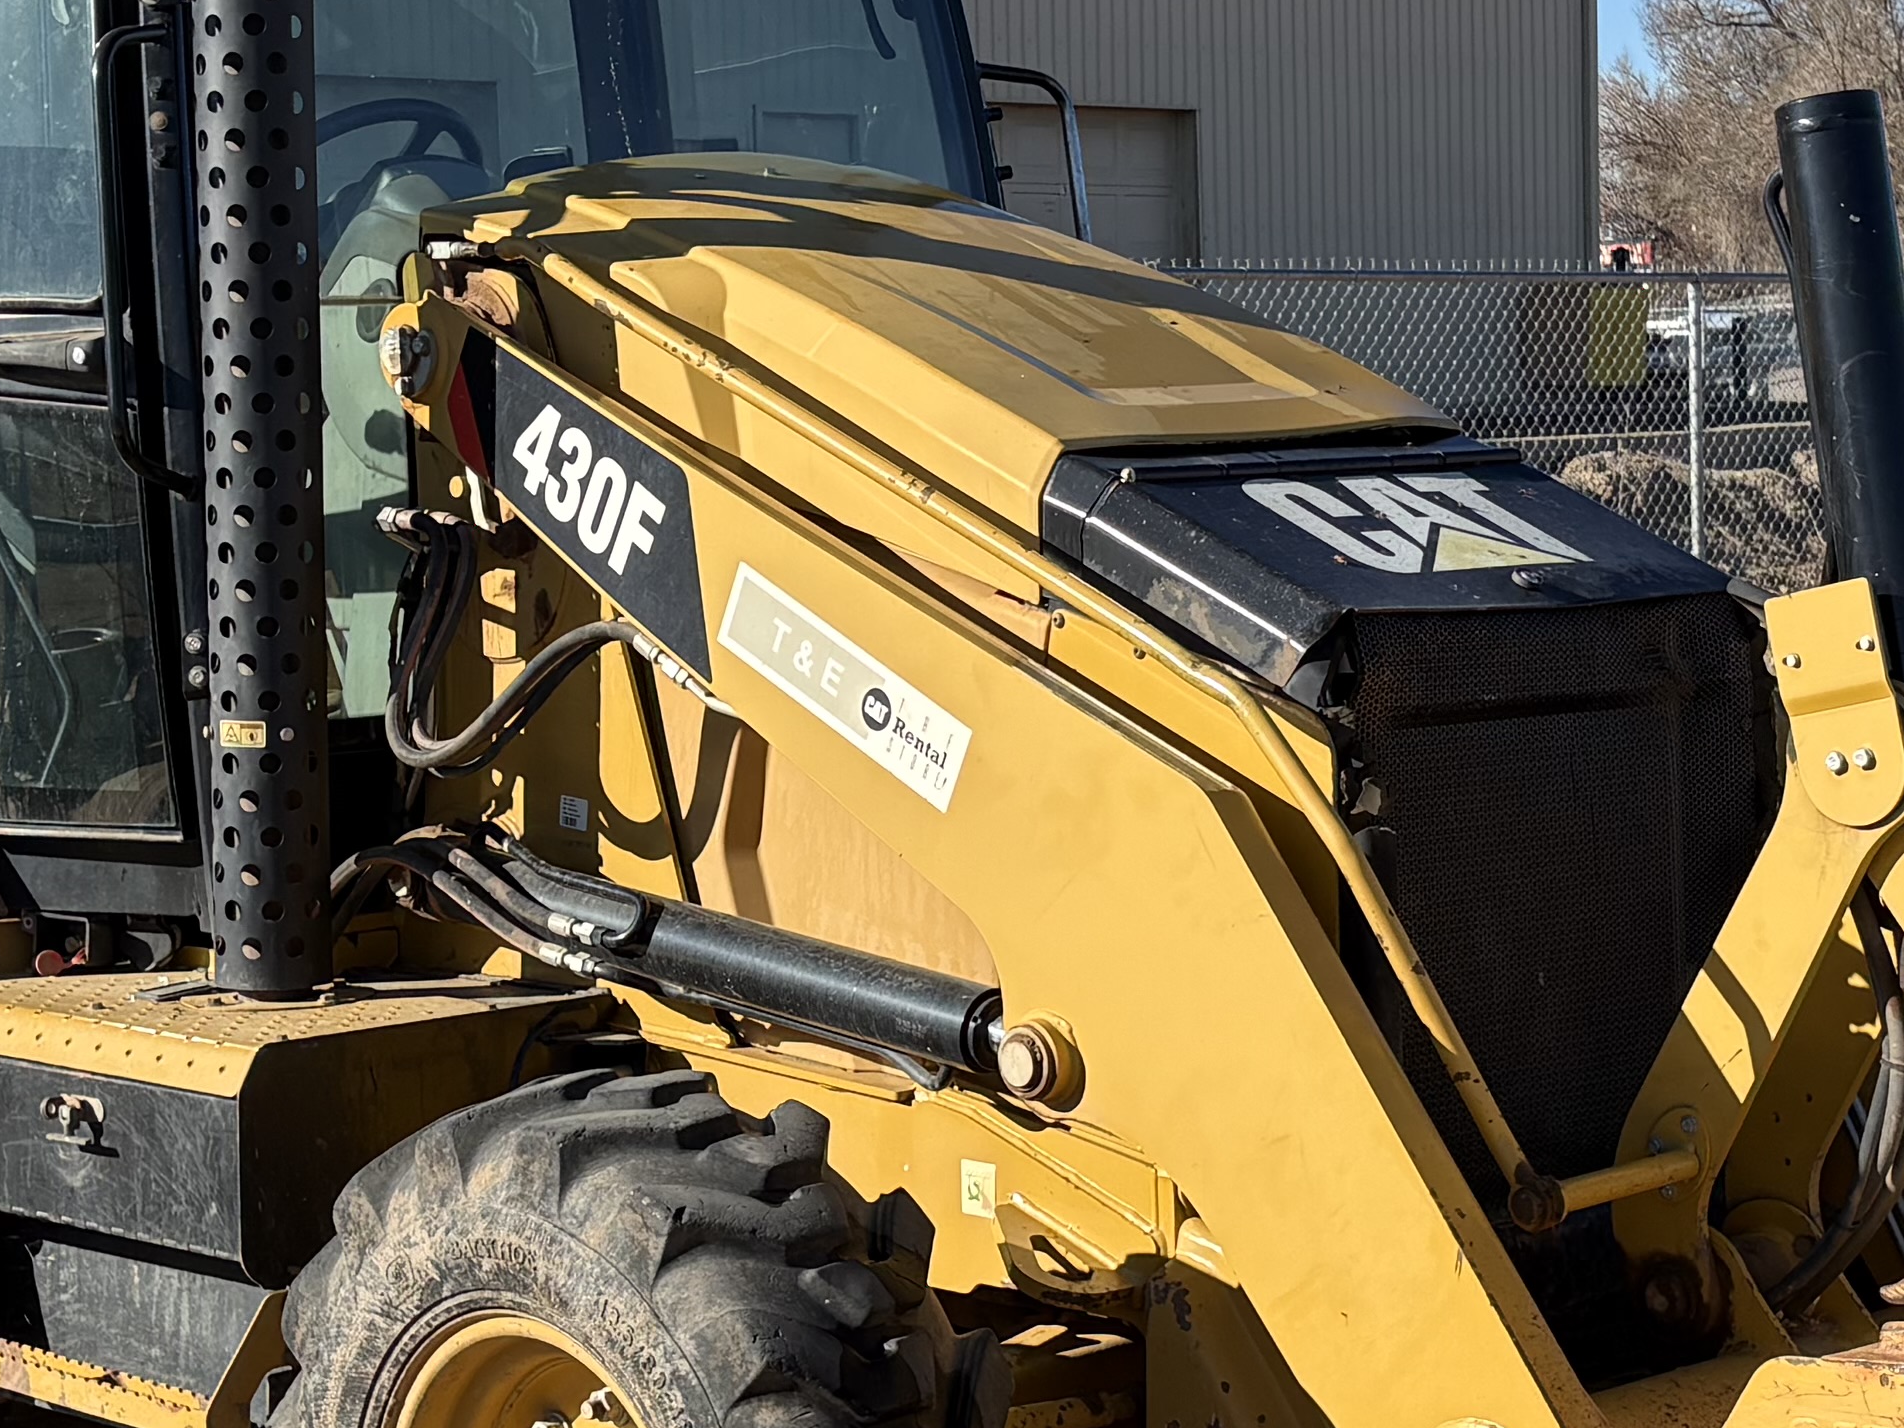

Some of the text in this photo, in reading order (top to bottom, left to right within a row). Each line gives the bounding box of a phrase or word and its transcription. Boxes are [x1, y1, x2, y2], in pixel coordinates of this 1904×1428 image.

[512, 403, 667, 576] 430F
[1241, 472, 1595, 573] CAT
[772, 617, 846, 698] T & E
[892, 715, 948, 770] Rental
